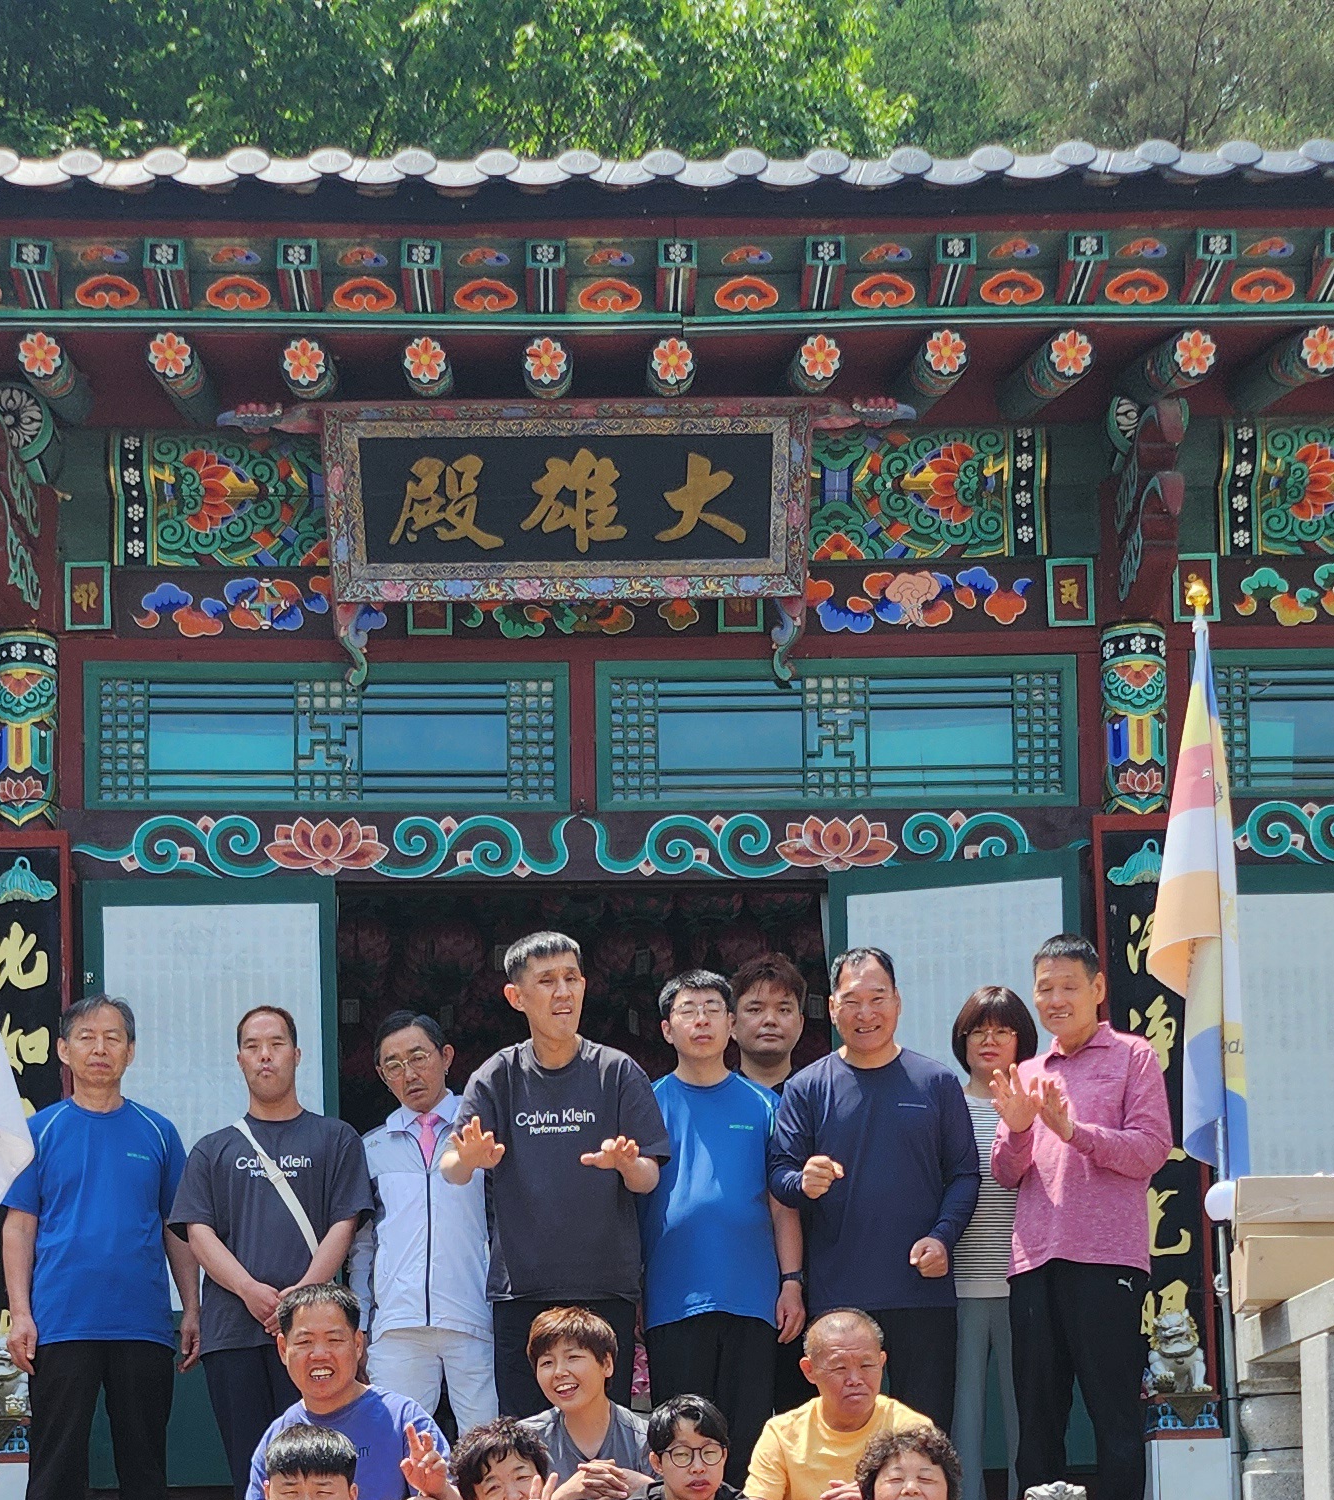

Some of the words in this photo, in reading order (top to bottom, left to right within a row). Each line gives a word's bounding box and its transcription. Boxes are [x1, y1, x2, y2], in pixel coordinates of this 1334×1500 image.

[515, 1110, 559, 1126] Calvin
[562, 1108, 596, 1123] Klein
[529, 1124, 581, 1135] Performance
[279, 1154, 313, 1169] Klein
